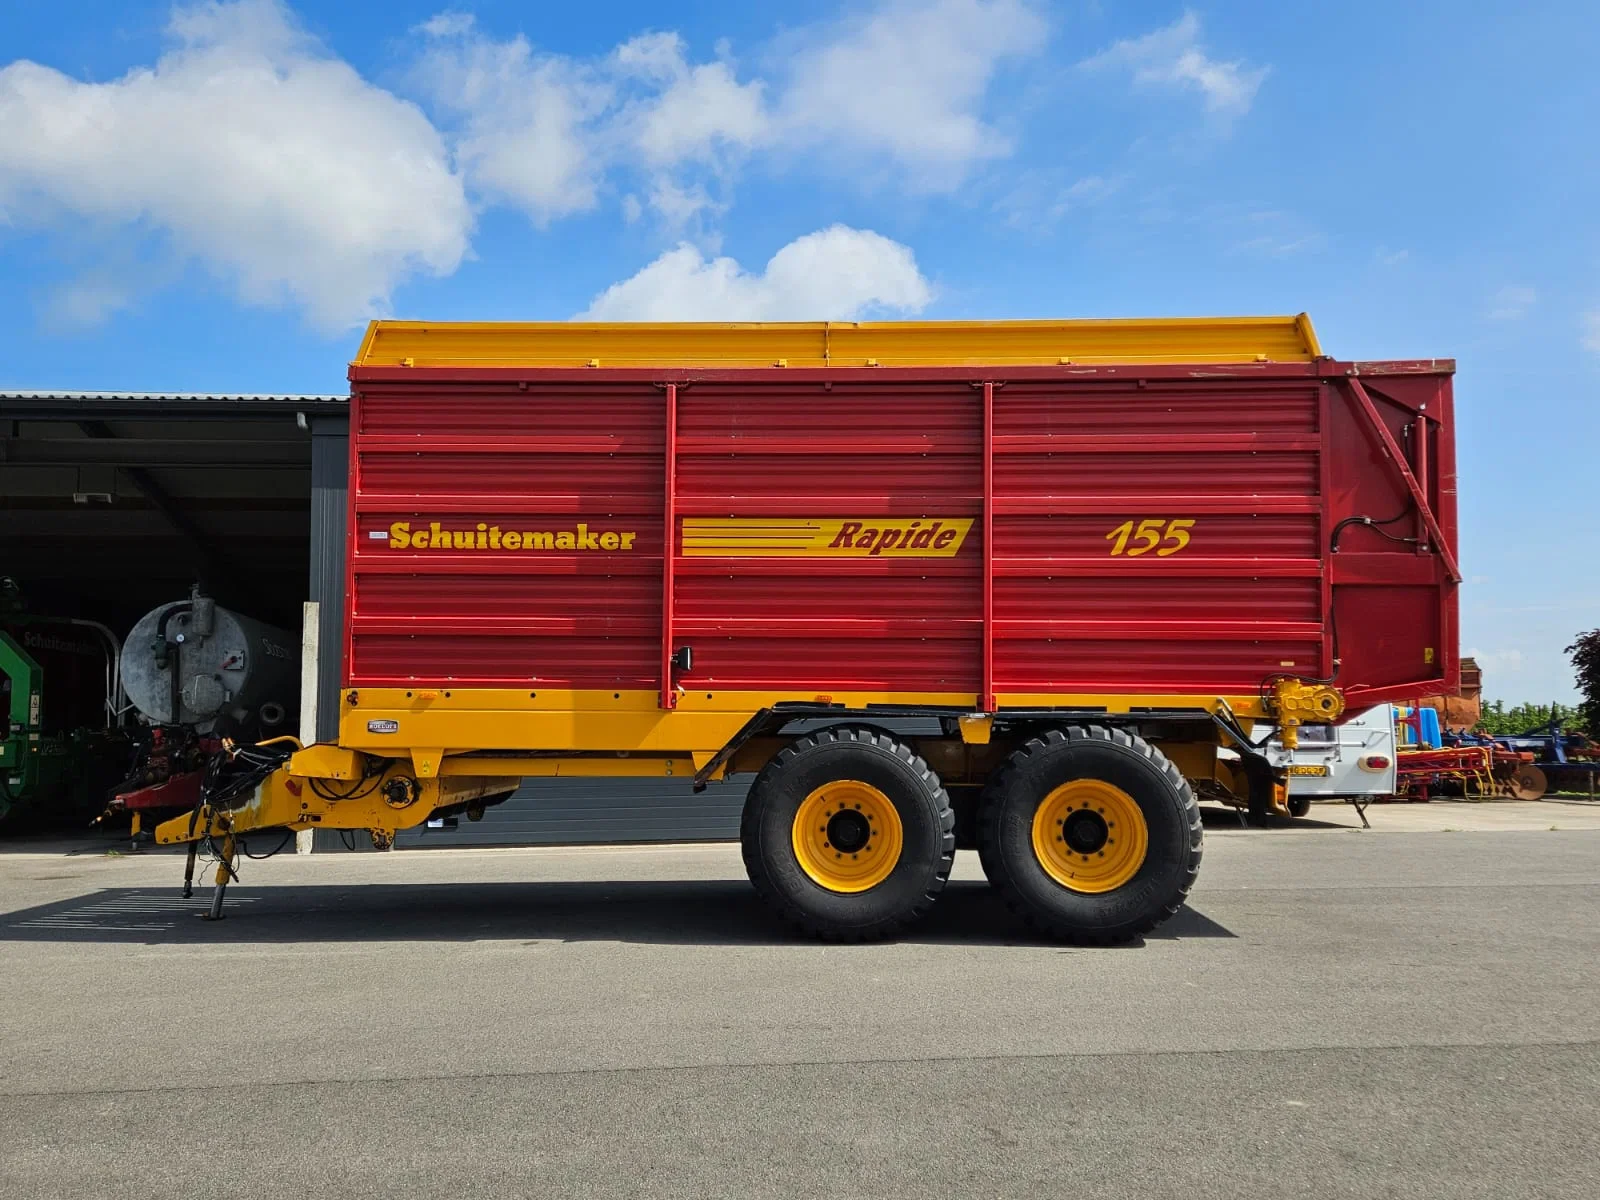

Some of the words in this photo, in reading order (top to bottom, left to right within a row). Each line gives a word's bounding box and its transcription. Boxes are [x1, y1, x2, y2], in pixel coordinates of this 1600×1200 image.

[389, 522, 636, 550] Schuitemaker
[828, 521, 957, 555] Rapide
[1105, 520, 1196, 557] 155
